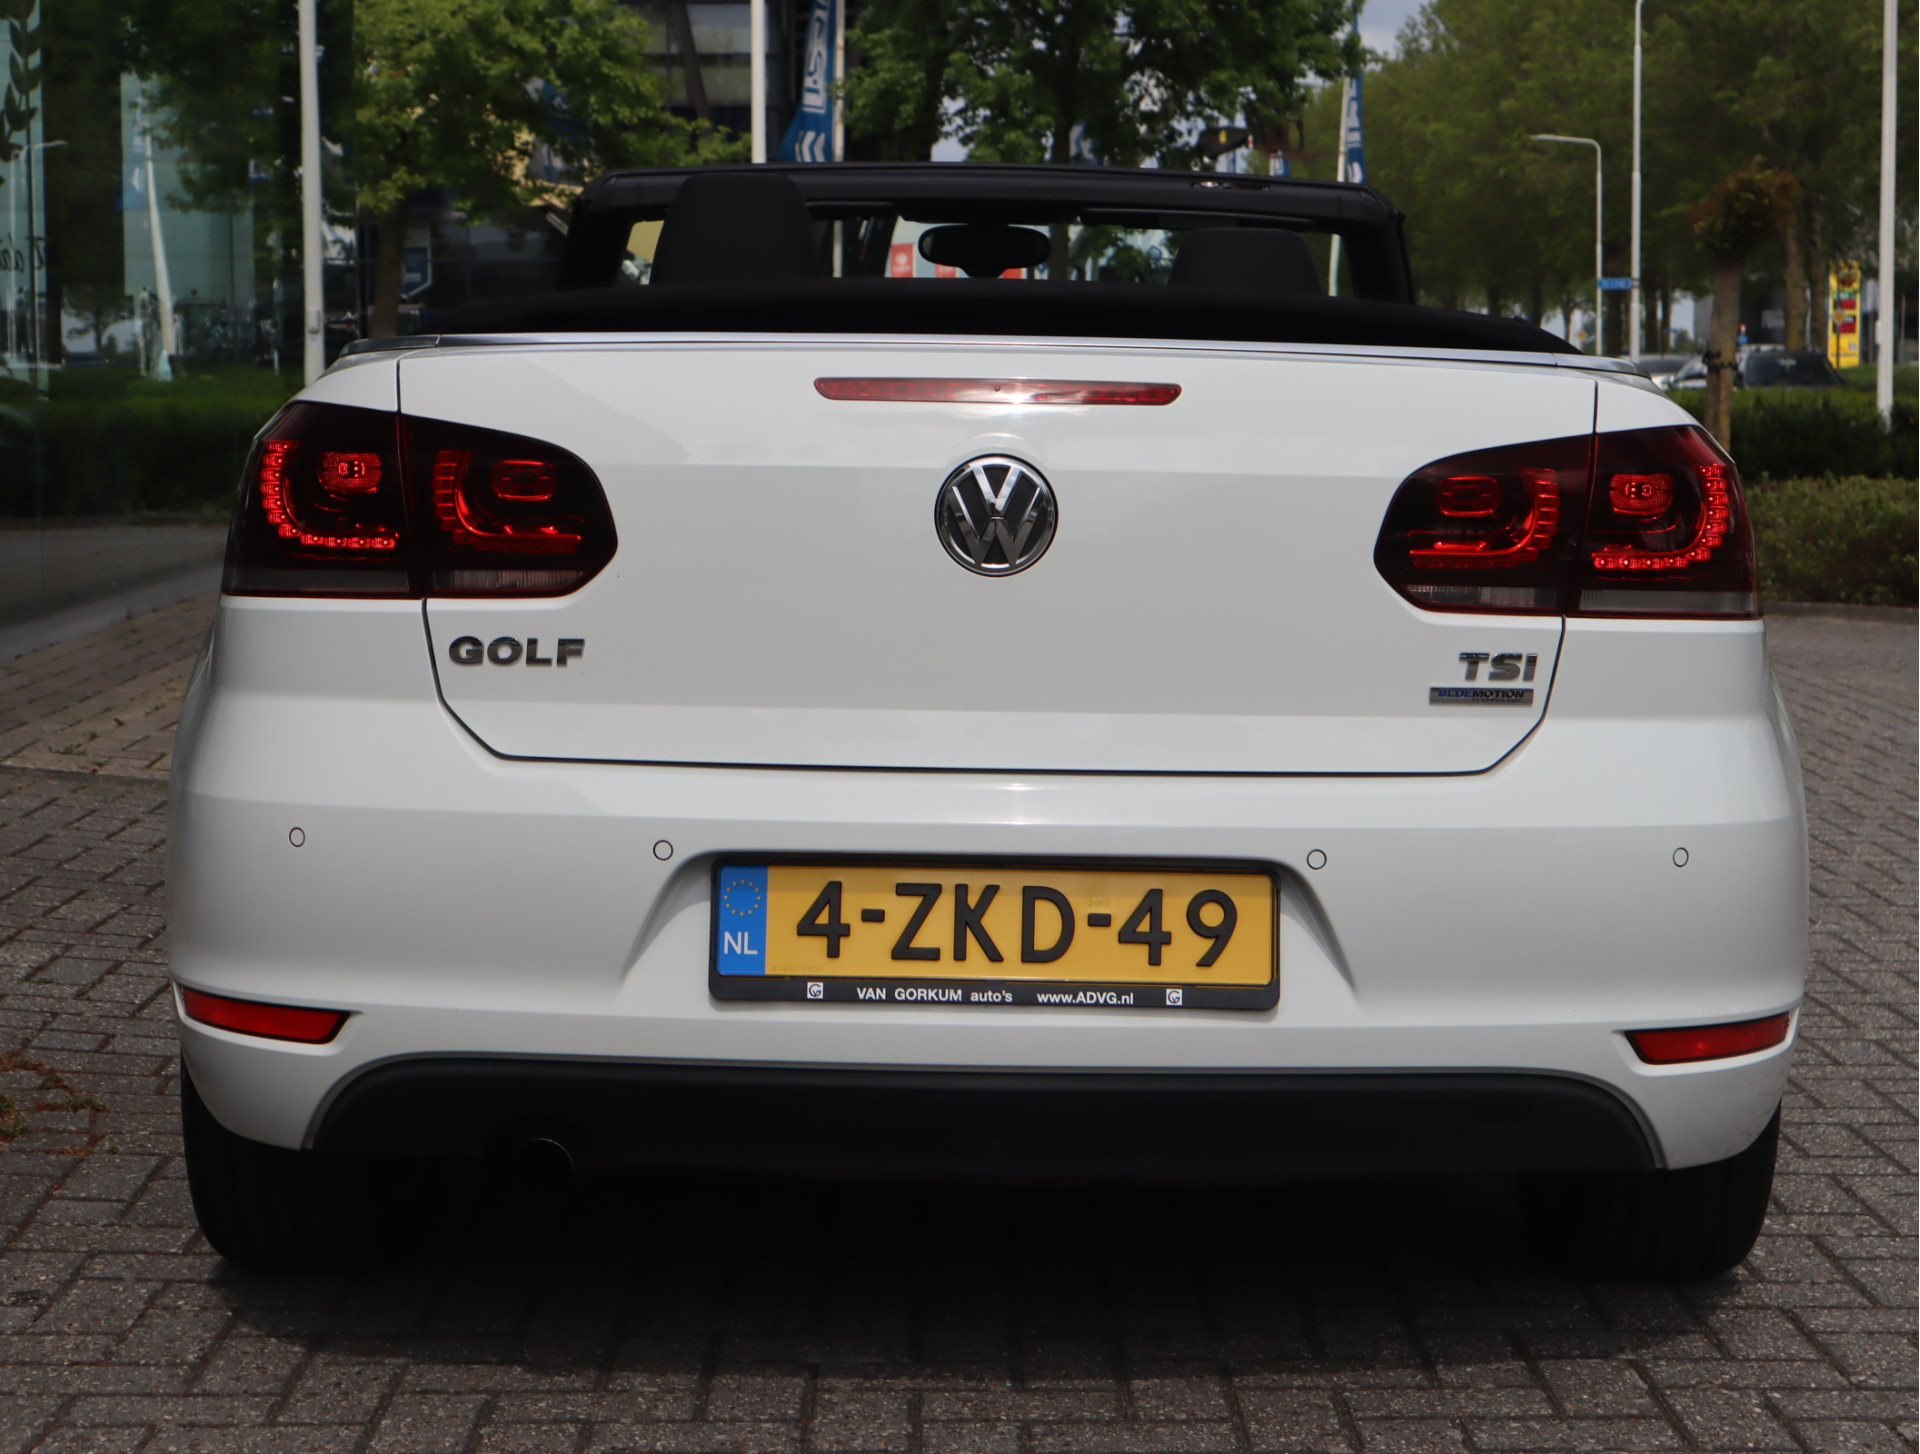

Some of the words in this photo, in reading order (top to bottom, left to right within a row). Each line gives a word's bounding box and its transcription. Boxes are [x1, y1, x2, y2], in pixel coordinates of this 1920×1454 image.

[448, 635, 586, 668] GOLF
[1458, 652, 1538, 682] TSI
[1438, 689, 1525, 698] BLUEMOTION
[796, 880, 1239, 968] 4-ZKD-49
[723, 931, 758, 955] NL
[856, 987, 887, 1001] VAN
[894, 988, 963, 1002] GORKUM
[970, 989, 1013, 1003] auto's
[1036, 990, 1134, 1006] www.ADVG.nl
